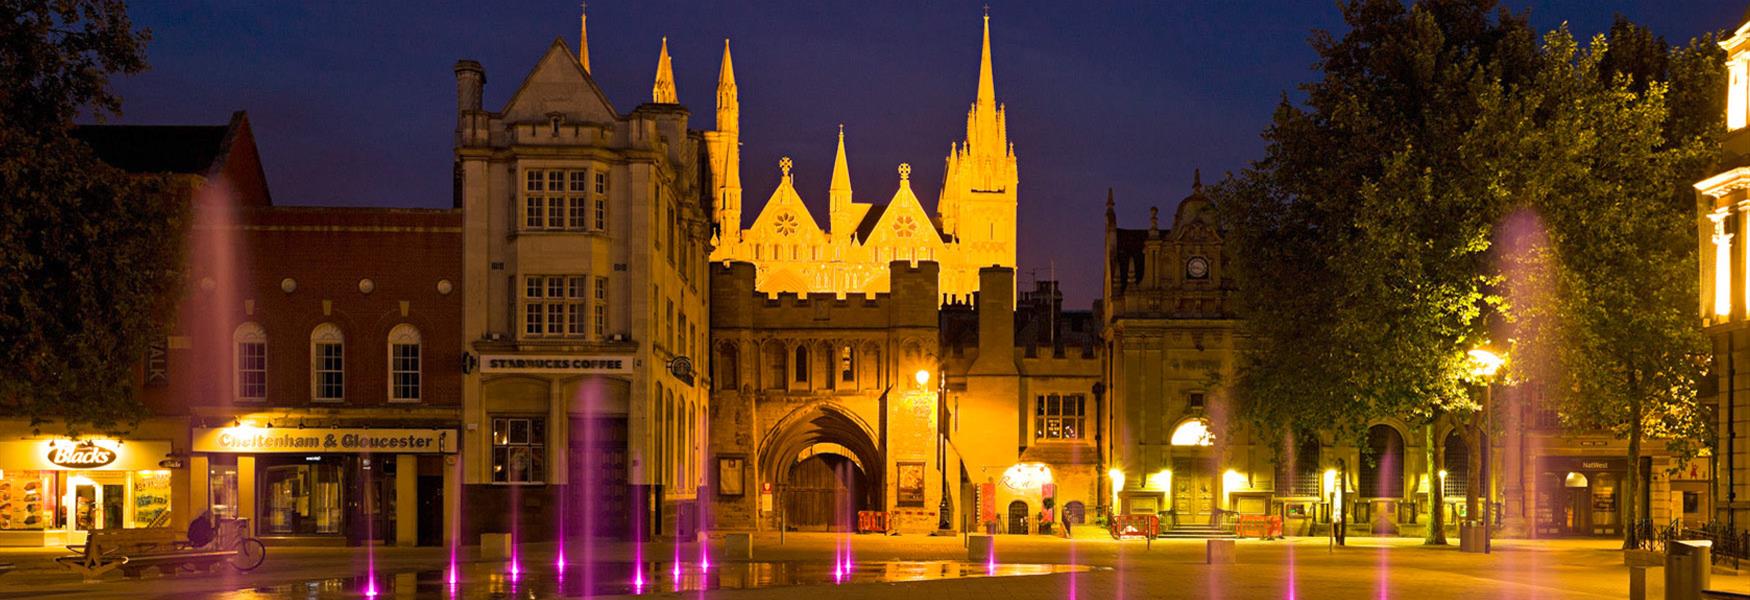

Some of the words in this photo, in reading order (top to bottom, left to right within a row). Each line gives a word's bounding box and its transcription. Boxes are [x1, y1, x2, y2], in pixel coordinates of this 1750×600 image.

[150, 343, 167, 382] ALK
[490, 359, 570, 369] STARBUCKS
[573, 359, 622, 369] COFFEE
[218, 432, 319, 448] Cheltenham
[324, 433, 337, 448] &
[341, 433, 433, 448] Gloucester
[53, 446, 111, 465] Blacks
